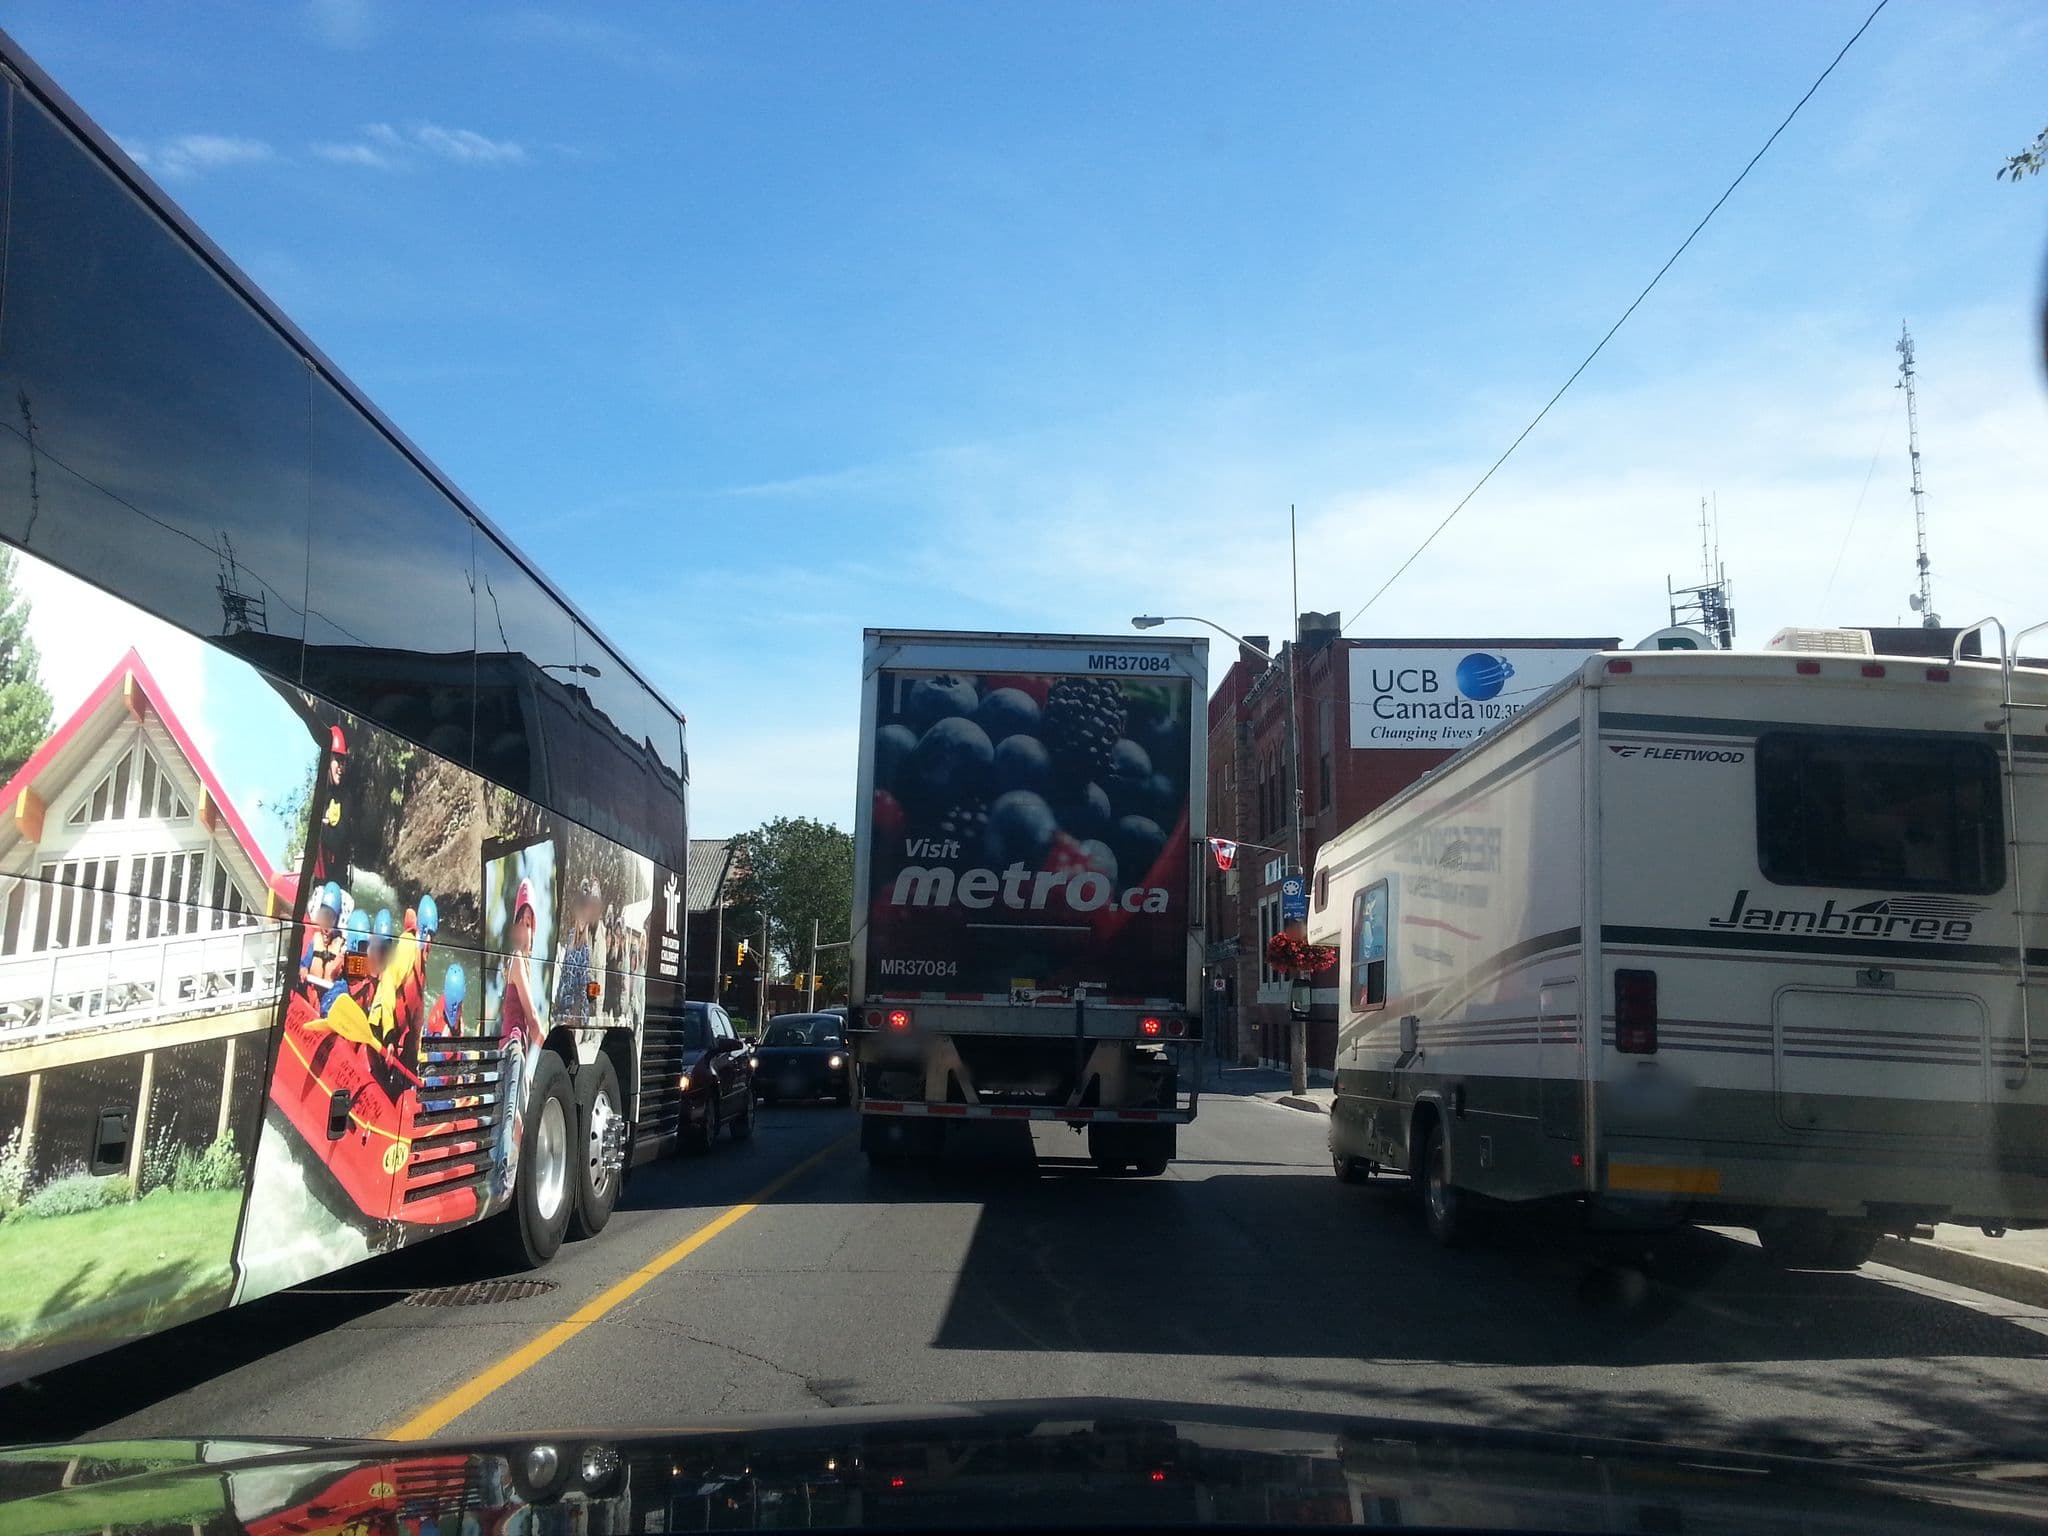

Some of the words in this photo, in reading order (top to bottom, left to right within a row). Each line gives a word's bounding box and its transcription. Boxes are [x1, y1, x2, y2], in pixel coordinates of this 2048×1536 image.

[1088, 654, 1171, 671] MR37084
[1372, 669, 1439, 694] UCB
[1372, 695, 1475, 720] Canada
[1478, 704, 1525, 719] 102.3F
[1371, 726, 1440, 742] Changing
[1442, 726, 1473, 738] lives
[1643, 747, 1745, 764] FLEETWOOD
[905, 838, 960, 859] Visit
[890, 861, 1169, 913] metro.ca
[1708, 889, 1973, 942] Jamboree
[881, 959, 958, 976] MR37084
